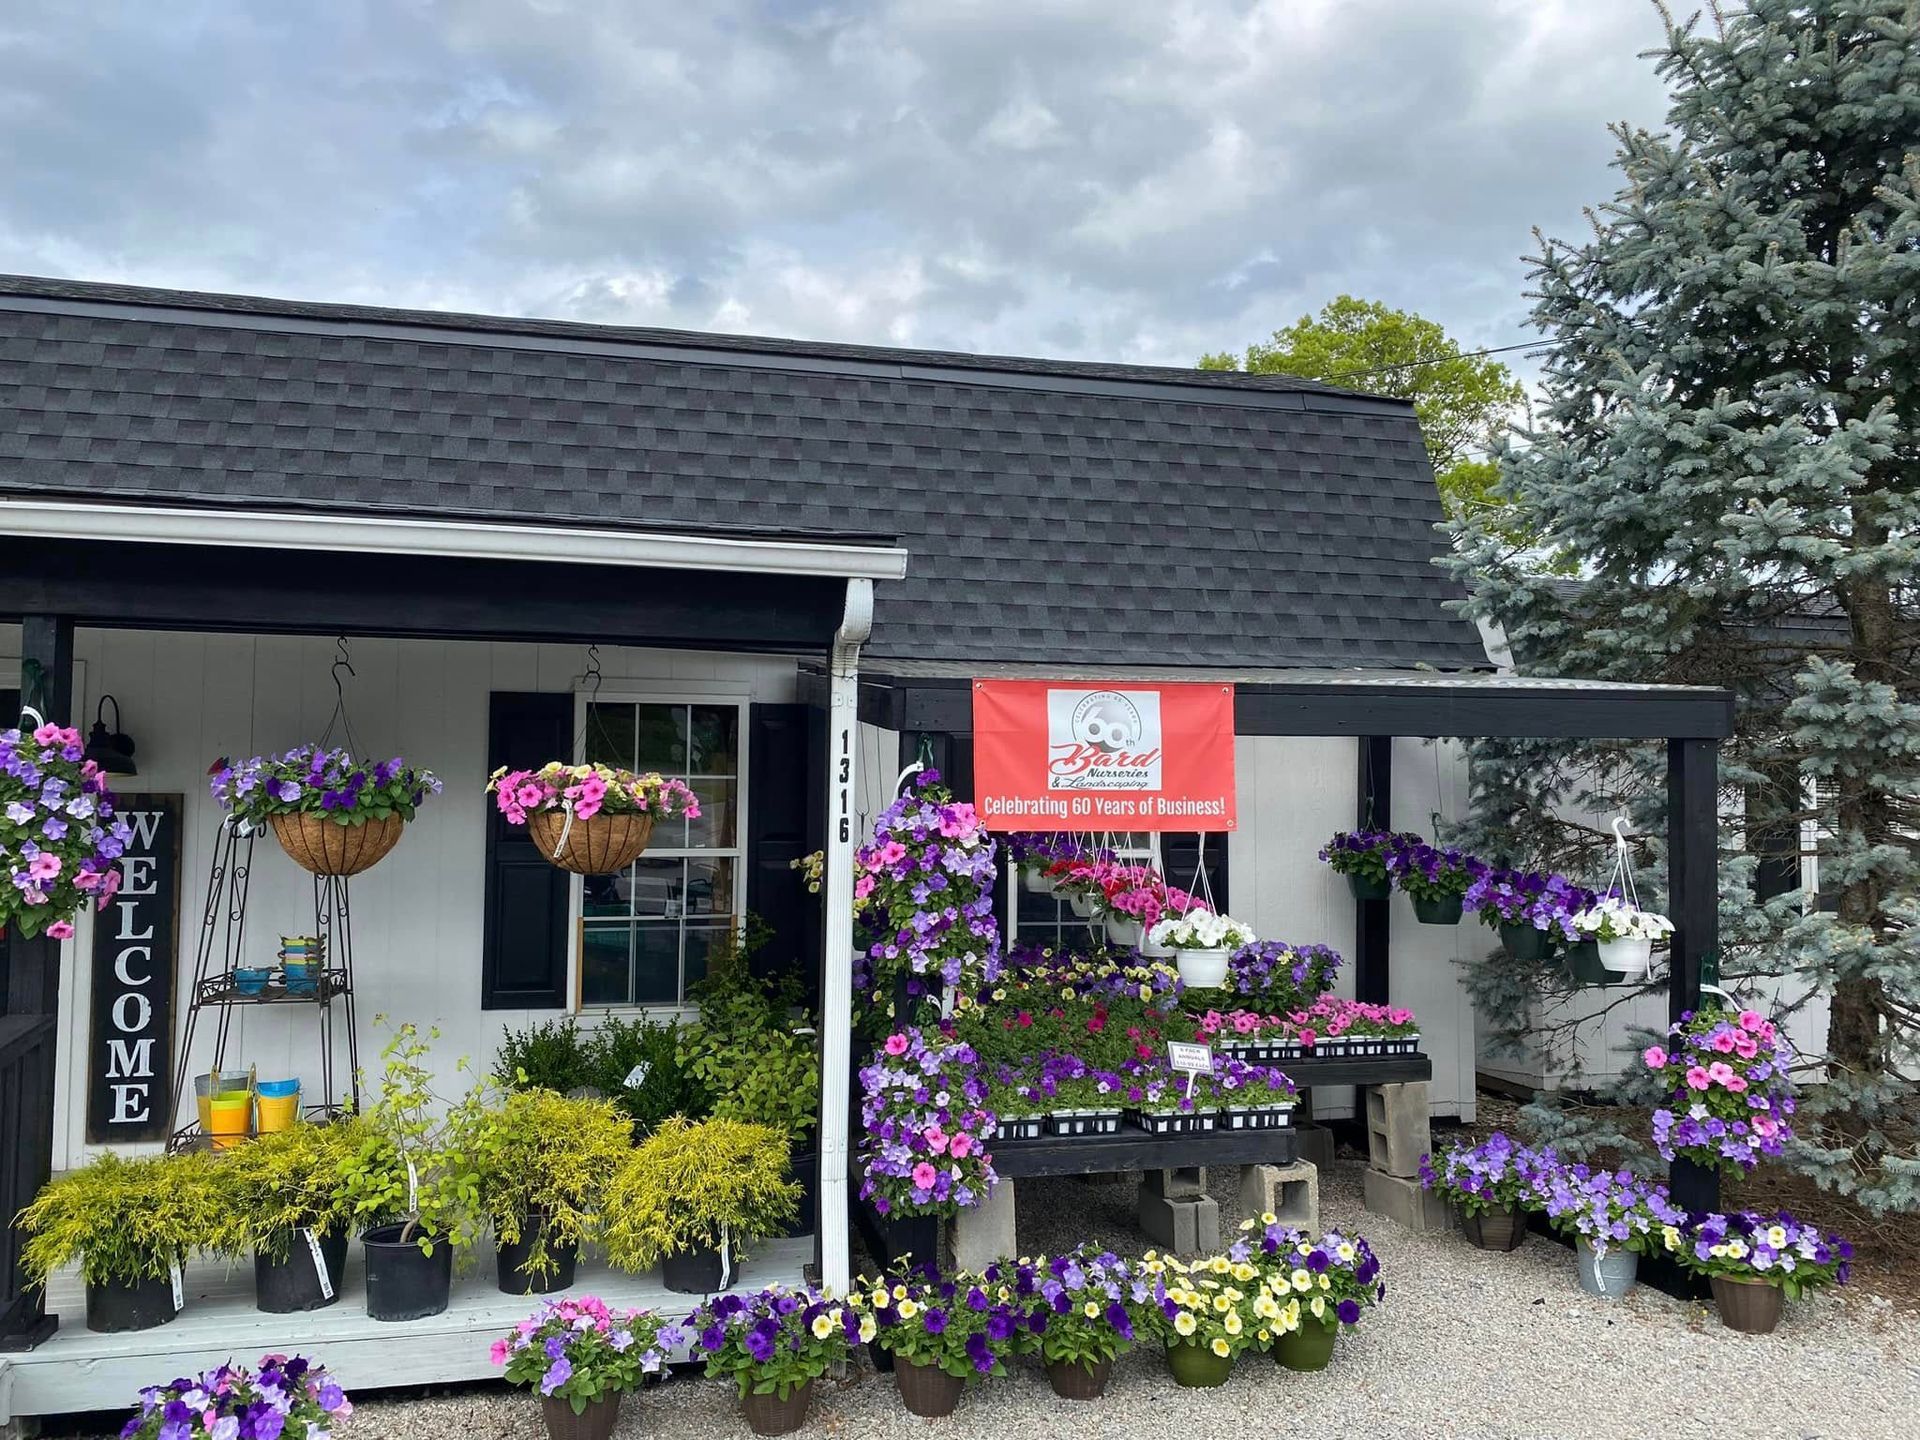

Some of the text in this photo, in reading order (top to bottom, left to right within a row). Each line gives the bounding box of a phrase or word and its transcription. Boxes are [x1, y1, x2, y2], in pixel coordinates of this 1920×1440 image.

[1049, 744, 1161, 775] Bard
[1087, 768, 1149, 778] Nurseries
[839, 729, 850, 843] 1316
[1052, 776, 1149, 790] & Landscaping
[984, 796, 1226, 819] Celebrating 60 Years of Business!
[105, 811, 164, 1124] WELCOME
